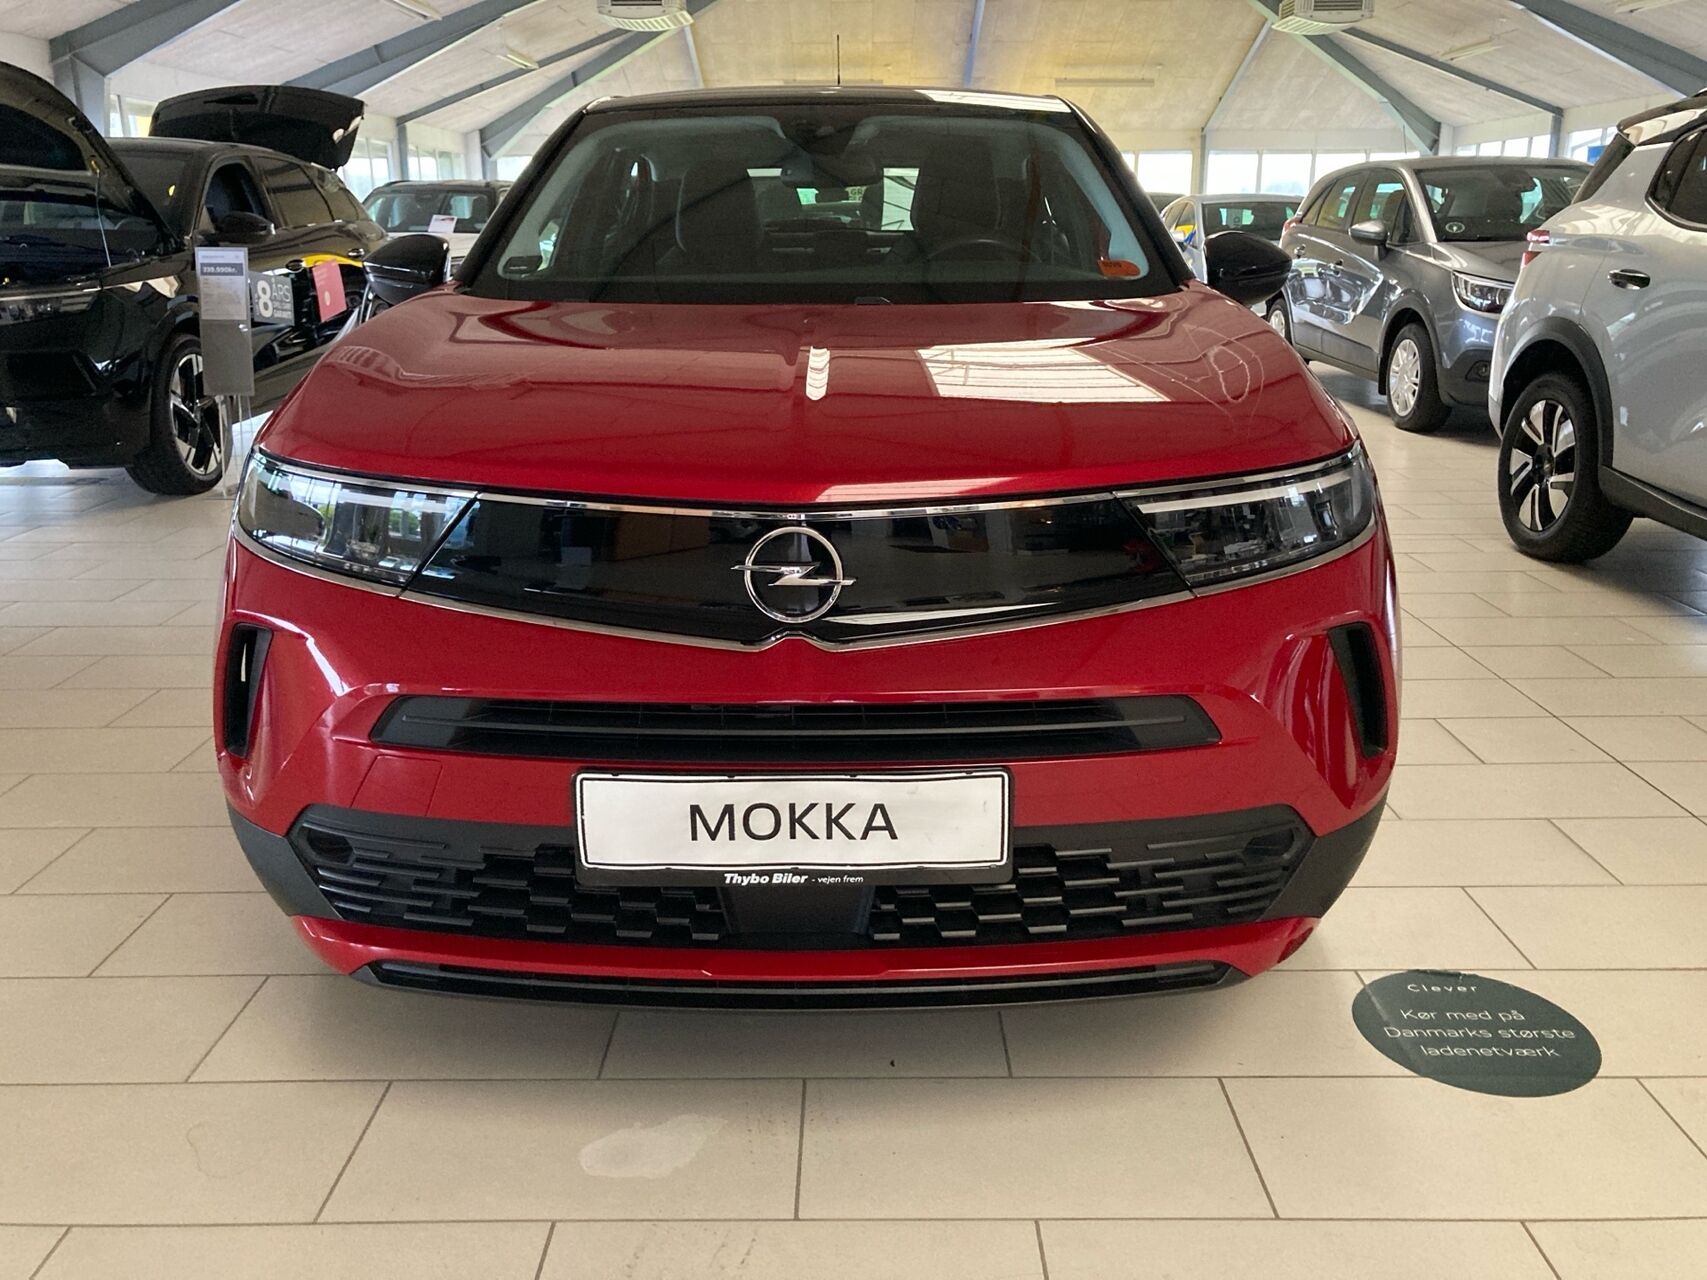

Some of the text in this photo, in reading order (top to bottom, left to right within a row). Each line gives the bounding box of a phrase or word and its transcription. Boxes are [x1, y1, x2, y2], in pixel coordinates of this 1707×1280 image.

[257, 280, 273, 318] 8
[689, 802, 898, 841] MOKKA
[724, 873, 769, 886] Thybo
[772, 873, 808, 884] Biler
[817, 875, 841, 885] vejen
[843, 874, 864, 883] frem
[1407, 983, 1477, 993] Clever
[1400, 1009, 1526, 1023] Kør med på
[1383, 1026, 1576, 1039] Danmarks største
[1420, 1045, 1562, 1057] ladenetværk
